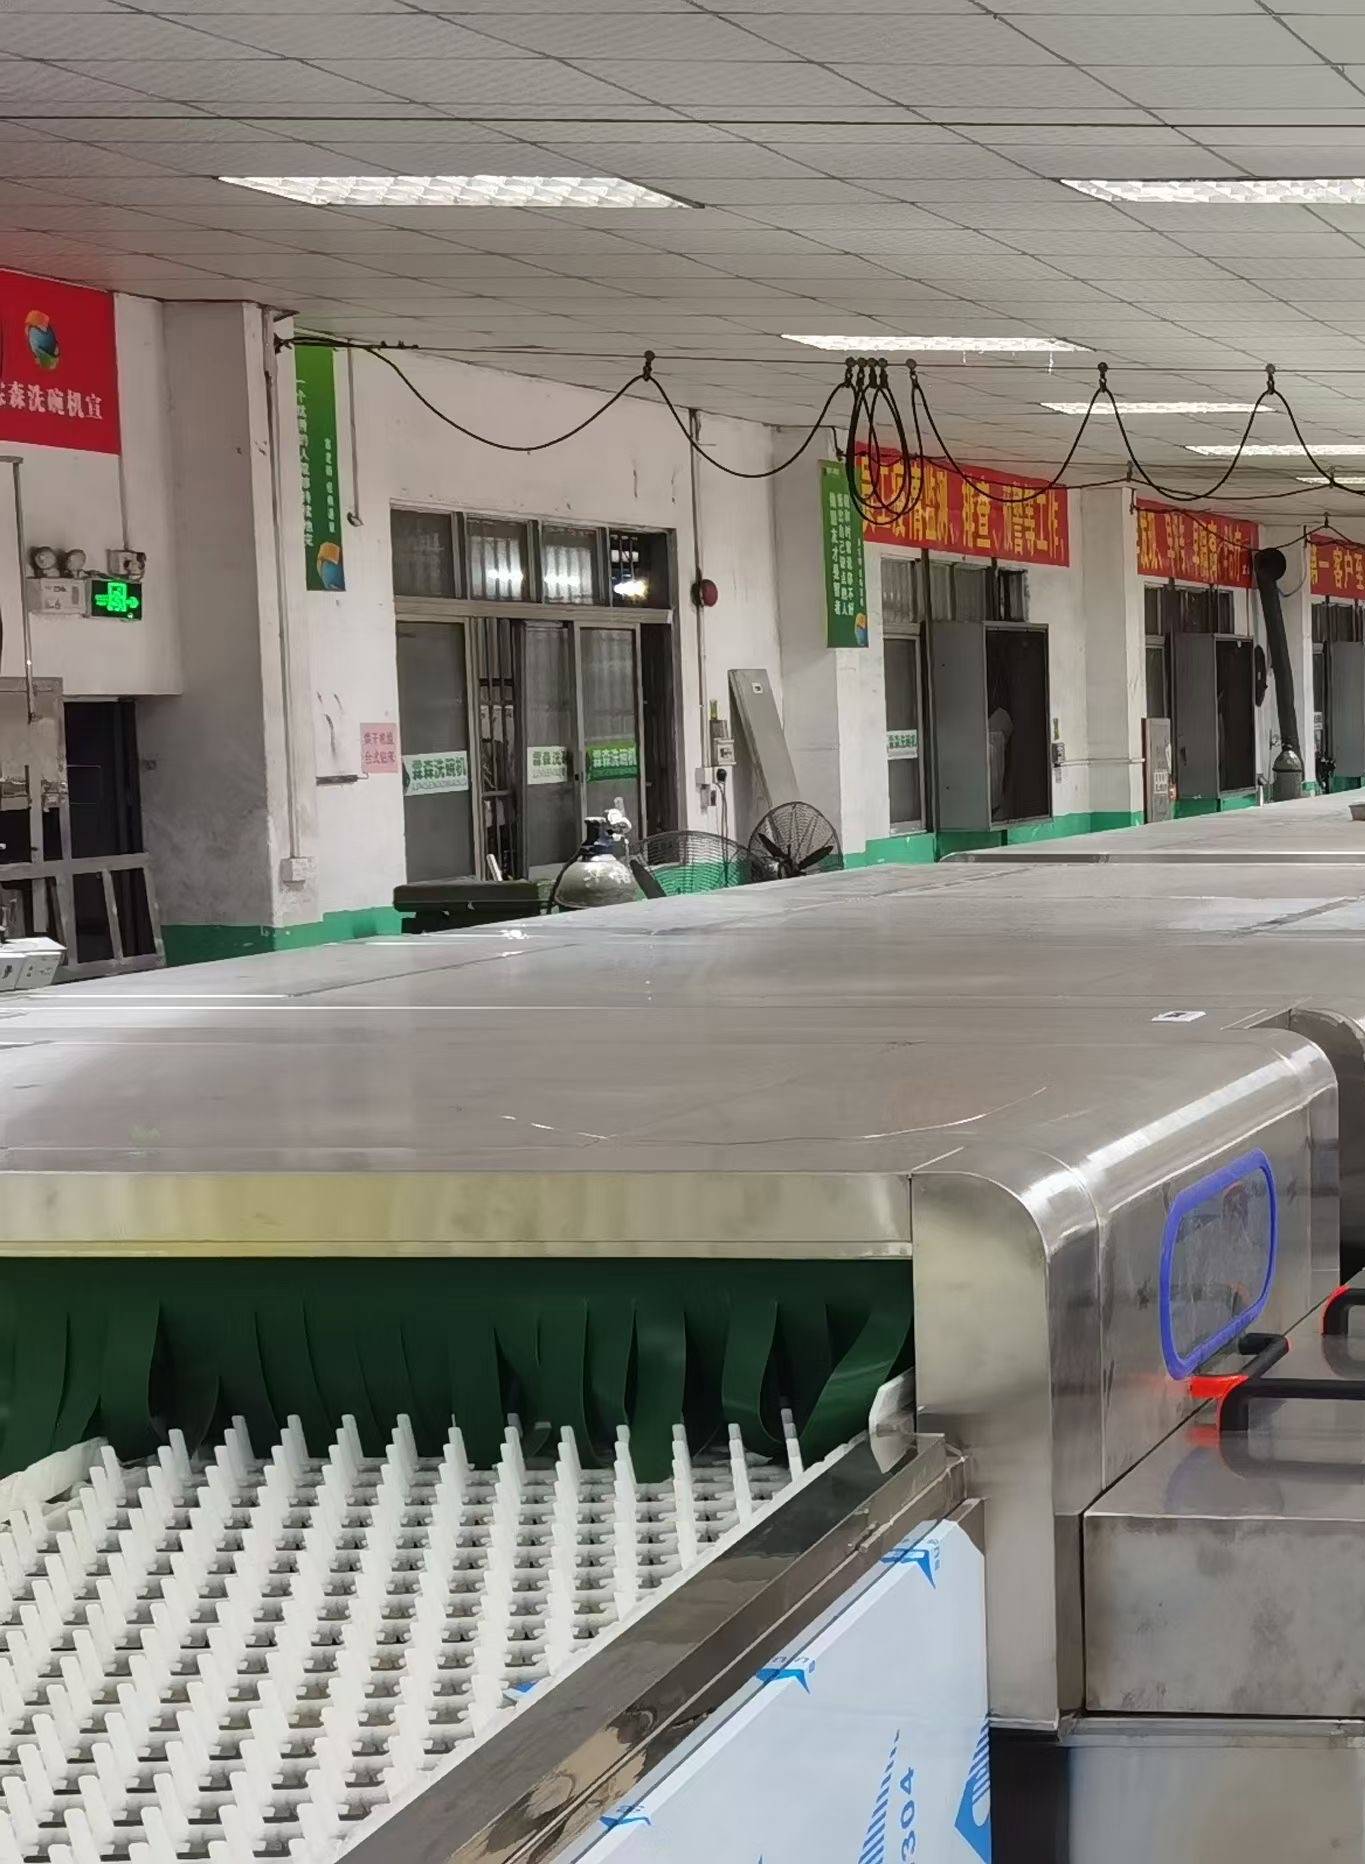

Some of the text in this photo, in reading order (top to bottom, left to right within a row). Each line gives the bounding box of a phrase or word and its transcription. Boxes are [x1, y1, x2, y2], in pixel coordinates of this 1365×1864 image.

[411, 757, 467, 780] 霖森洗碗机
